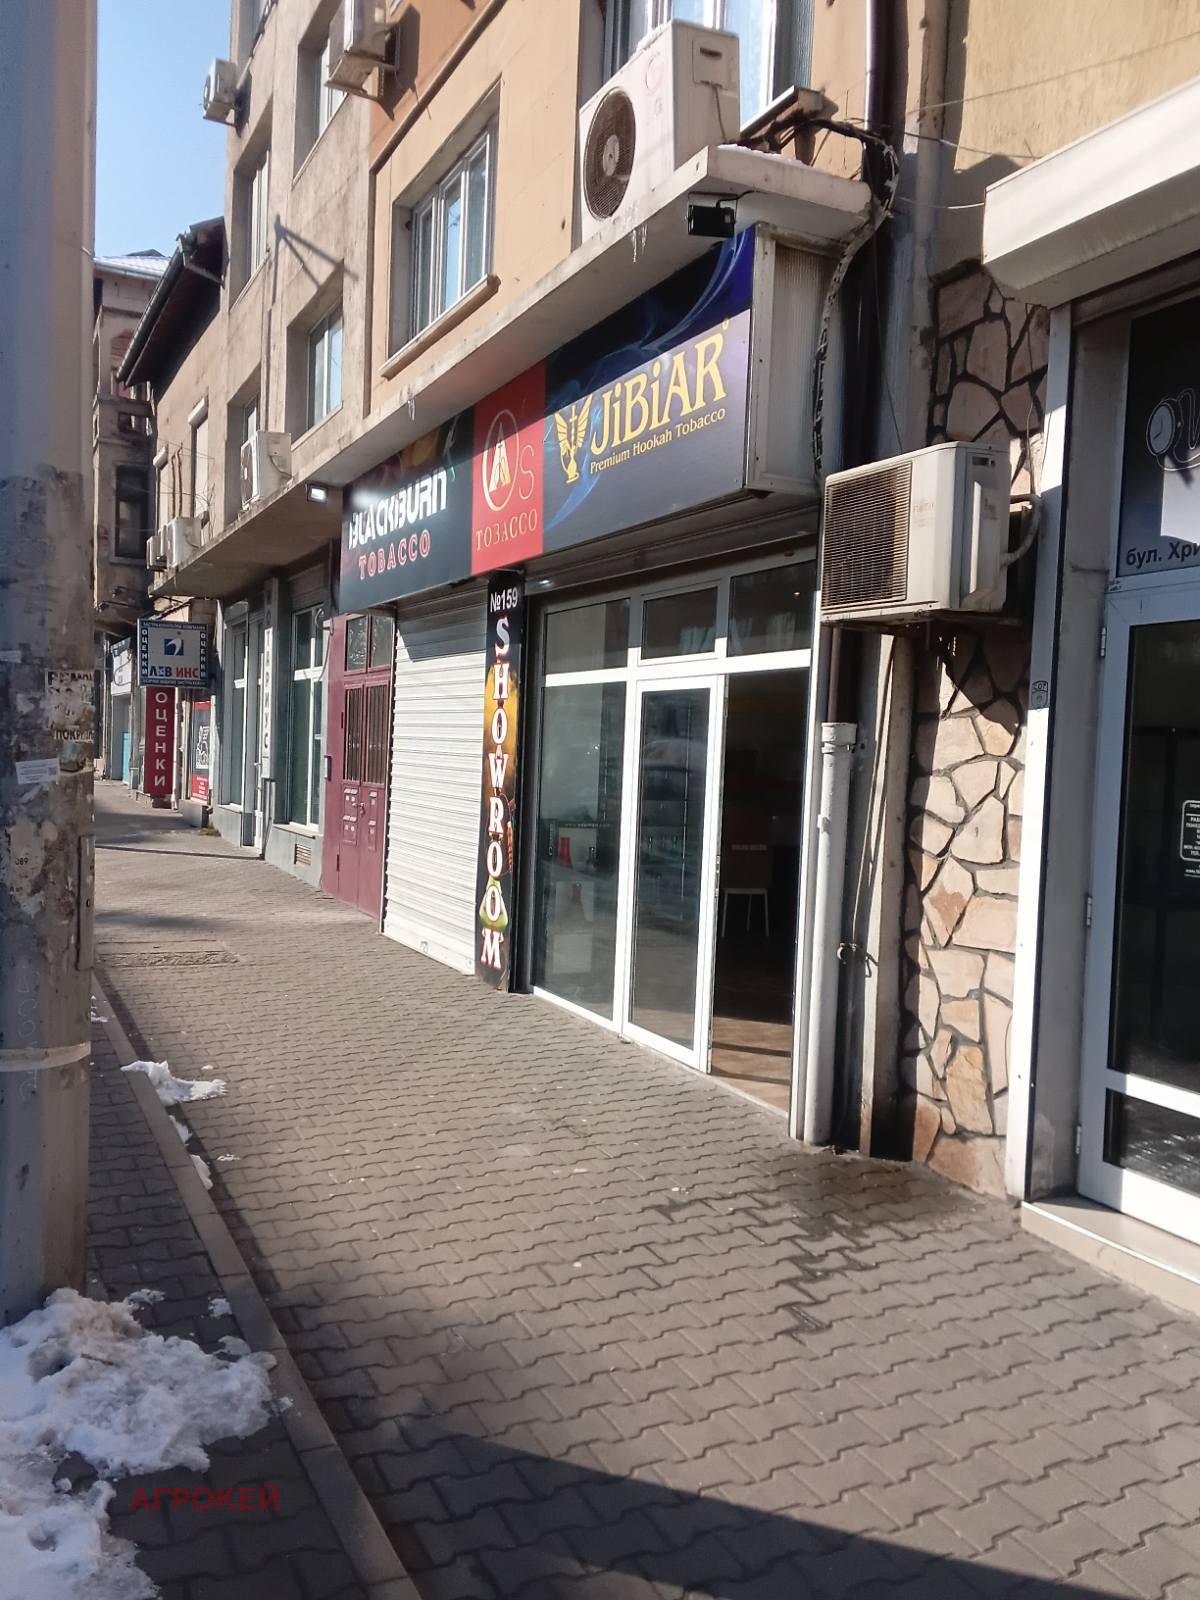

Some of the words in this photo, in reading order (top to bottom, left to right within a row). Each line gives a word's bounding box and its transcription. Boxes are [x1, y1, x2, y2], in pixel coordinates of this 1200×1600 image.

[590, 449, 631, 475] Premium
[632, 428, 673, 457] Hookah
[675, 408, 726, 438] Tobacco
[348, 466, 448, 551] BLACKBURN
[475, 508, 538, 551] TOBACCO
[358, 528, 431, 580] TOBACCO
[1126, 547, 1162, 569] бул.
[490, 587, 518, 612] №159
[176, 667, 200, 678] ИНС
[155, 691, 168, 788] ОЦЕНКИ
